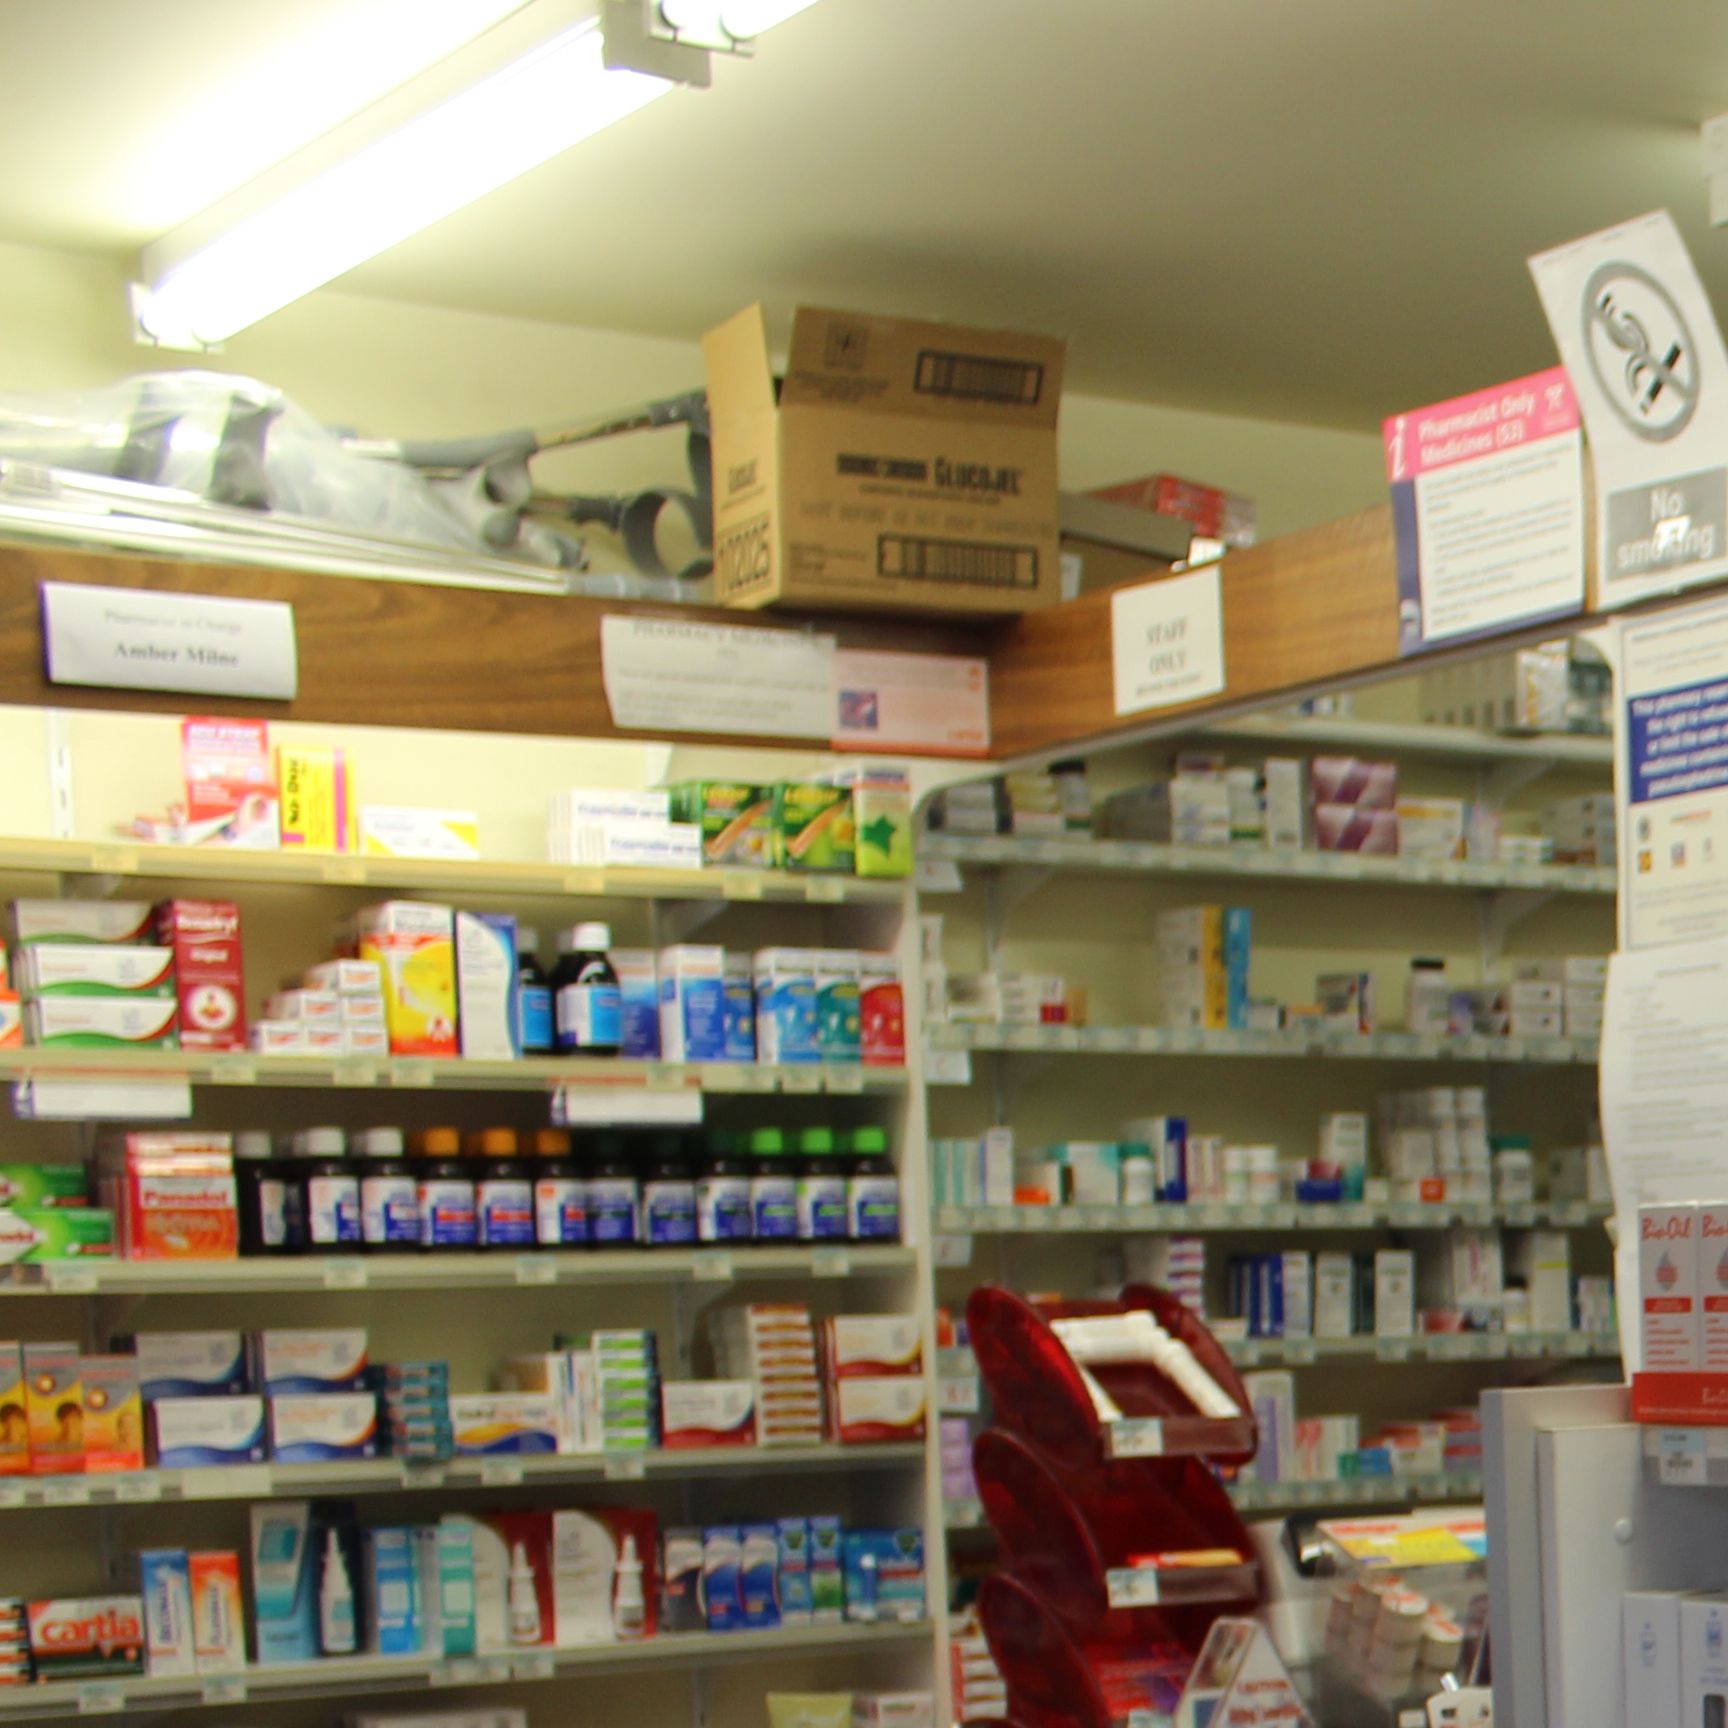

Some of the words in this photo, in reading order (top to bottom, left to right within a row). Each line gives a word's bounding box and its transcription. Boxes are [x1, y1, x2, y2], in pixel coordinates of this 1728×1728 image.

[1499, 389, 1537, 420] Only
[1419, 431, 1492, 466] Medicines
[1649, 487, 1683, 515] No
[40, 1612, 139, 1652] cartia
